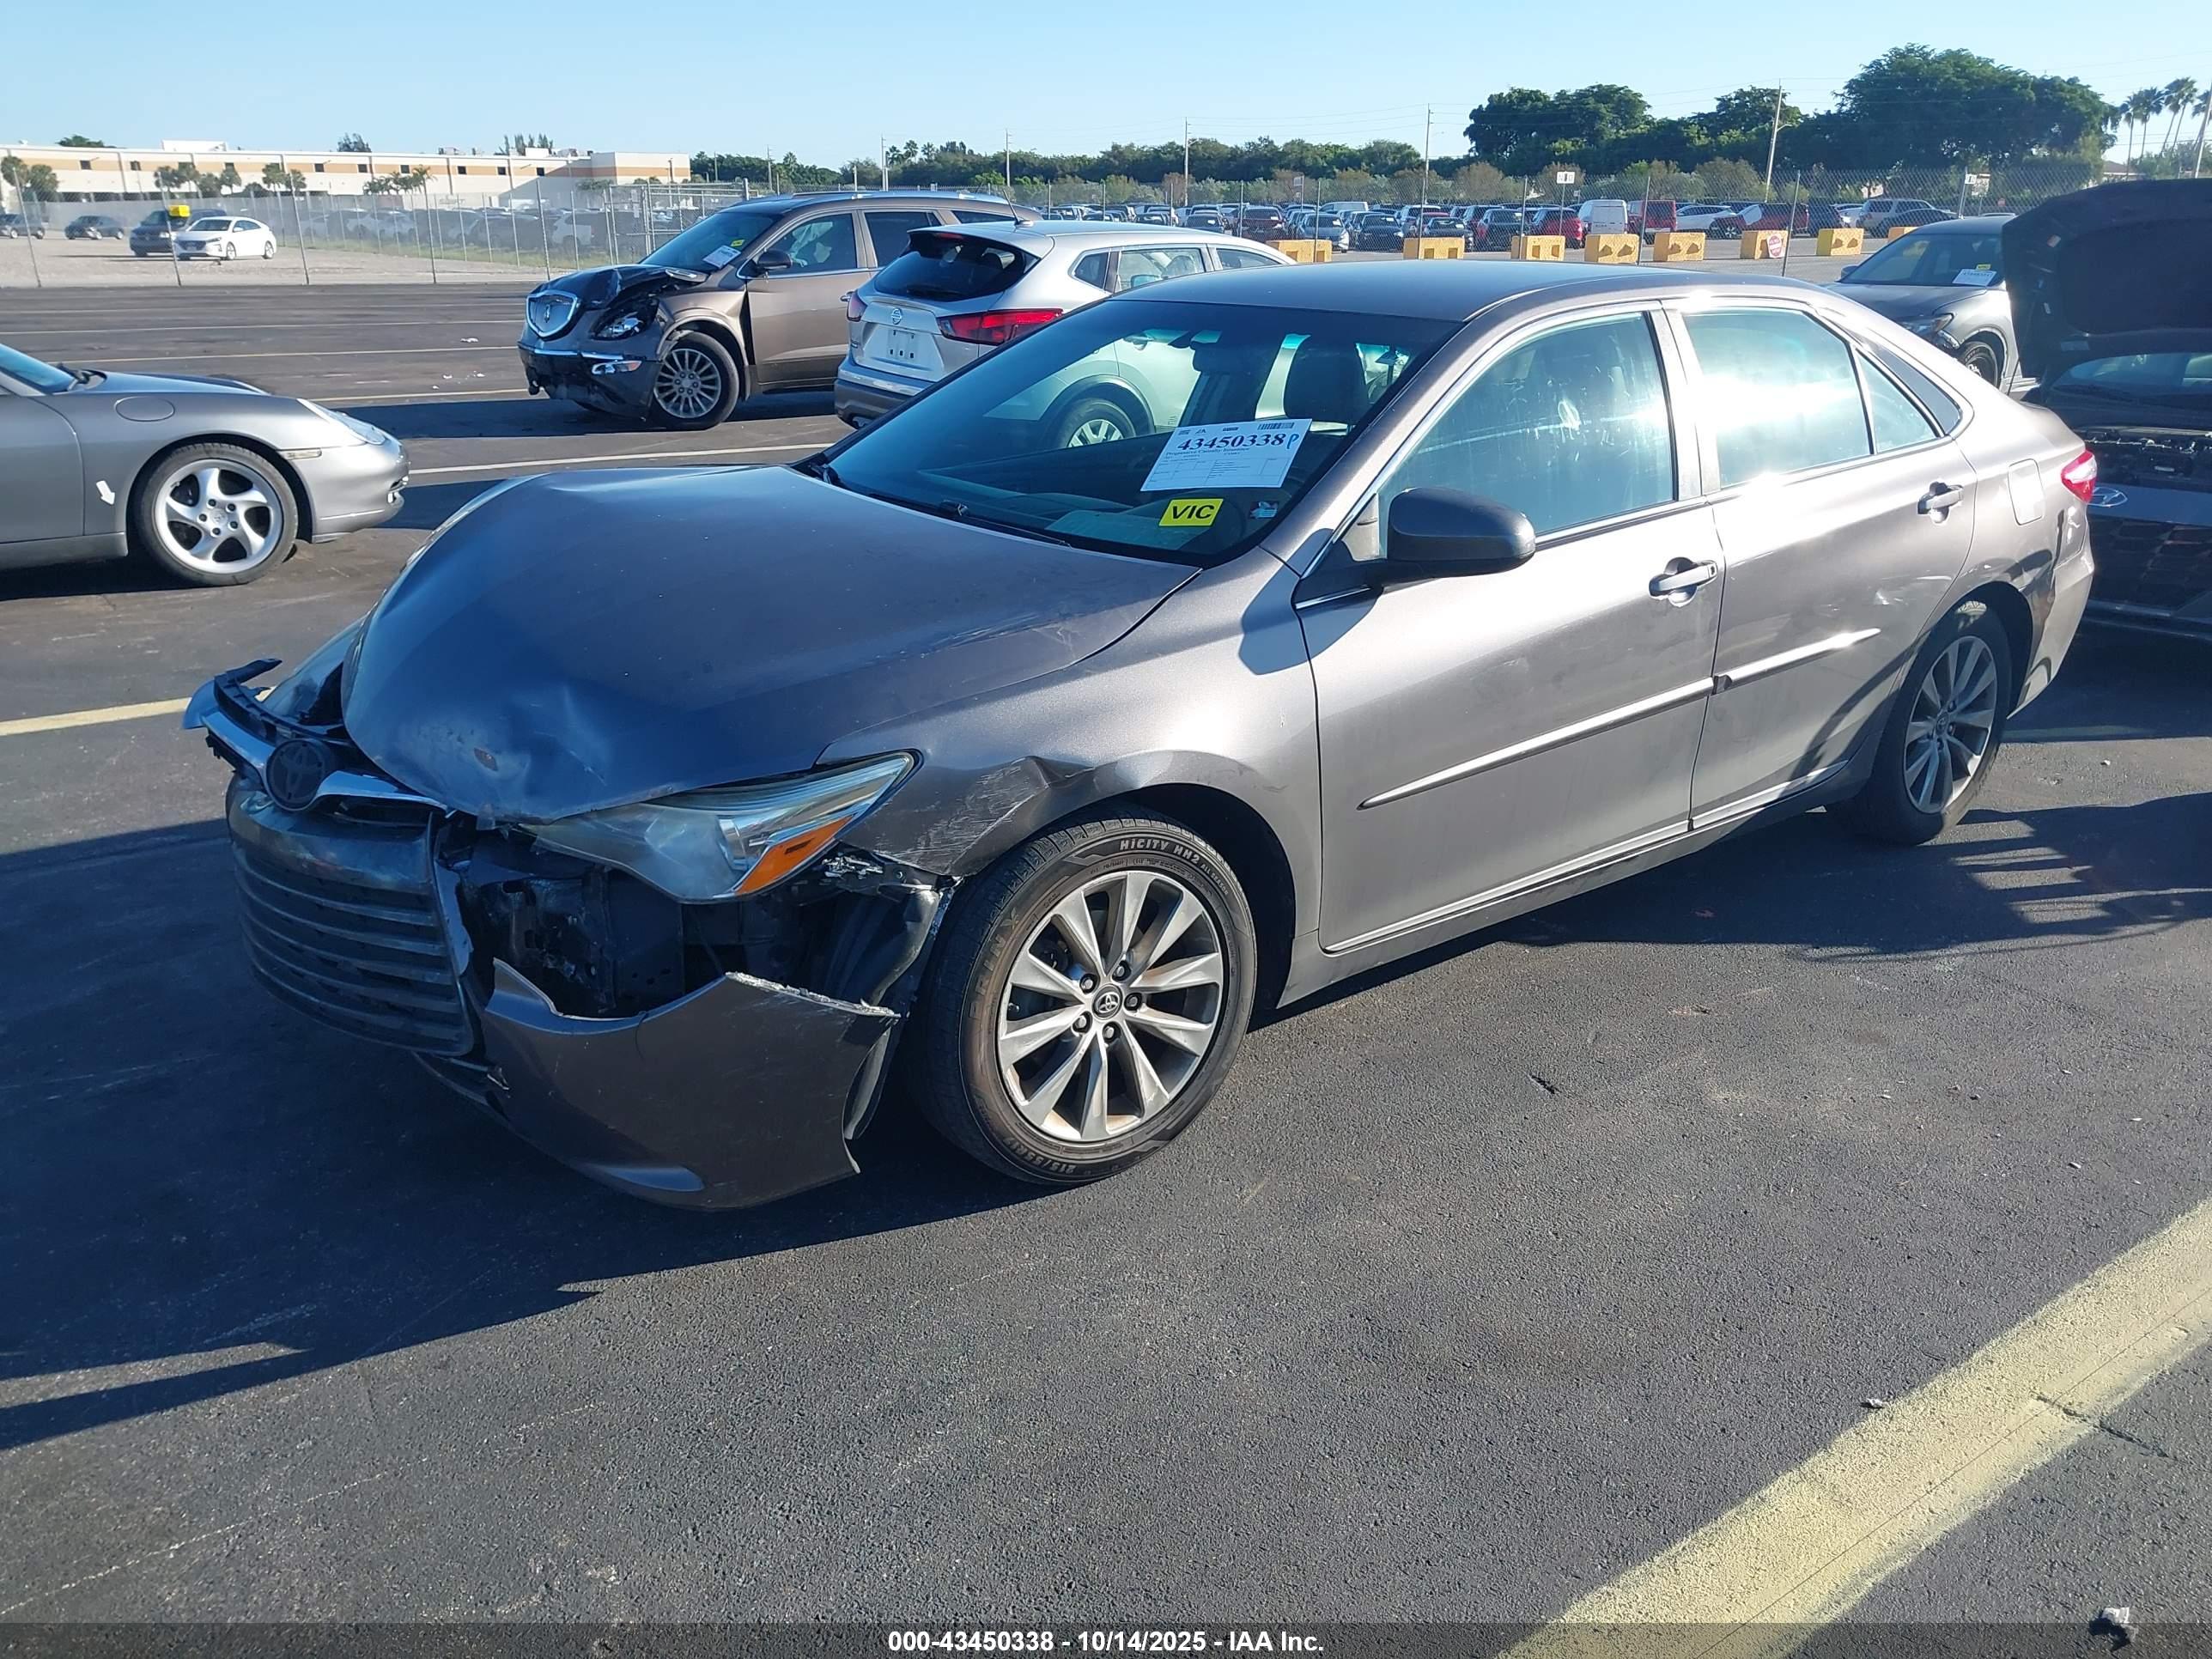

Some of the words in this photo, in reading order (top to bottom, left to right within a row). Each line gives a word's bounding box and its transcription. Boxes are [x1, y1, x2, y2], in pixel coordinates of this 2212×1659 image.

[1177, 433, 1286, 451] 43450338
[1170, 505, 1214, 520] VIC
[1200, 864, 1212, 874] ALL
[1211, 872, 1229, 895] SEASON
